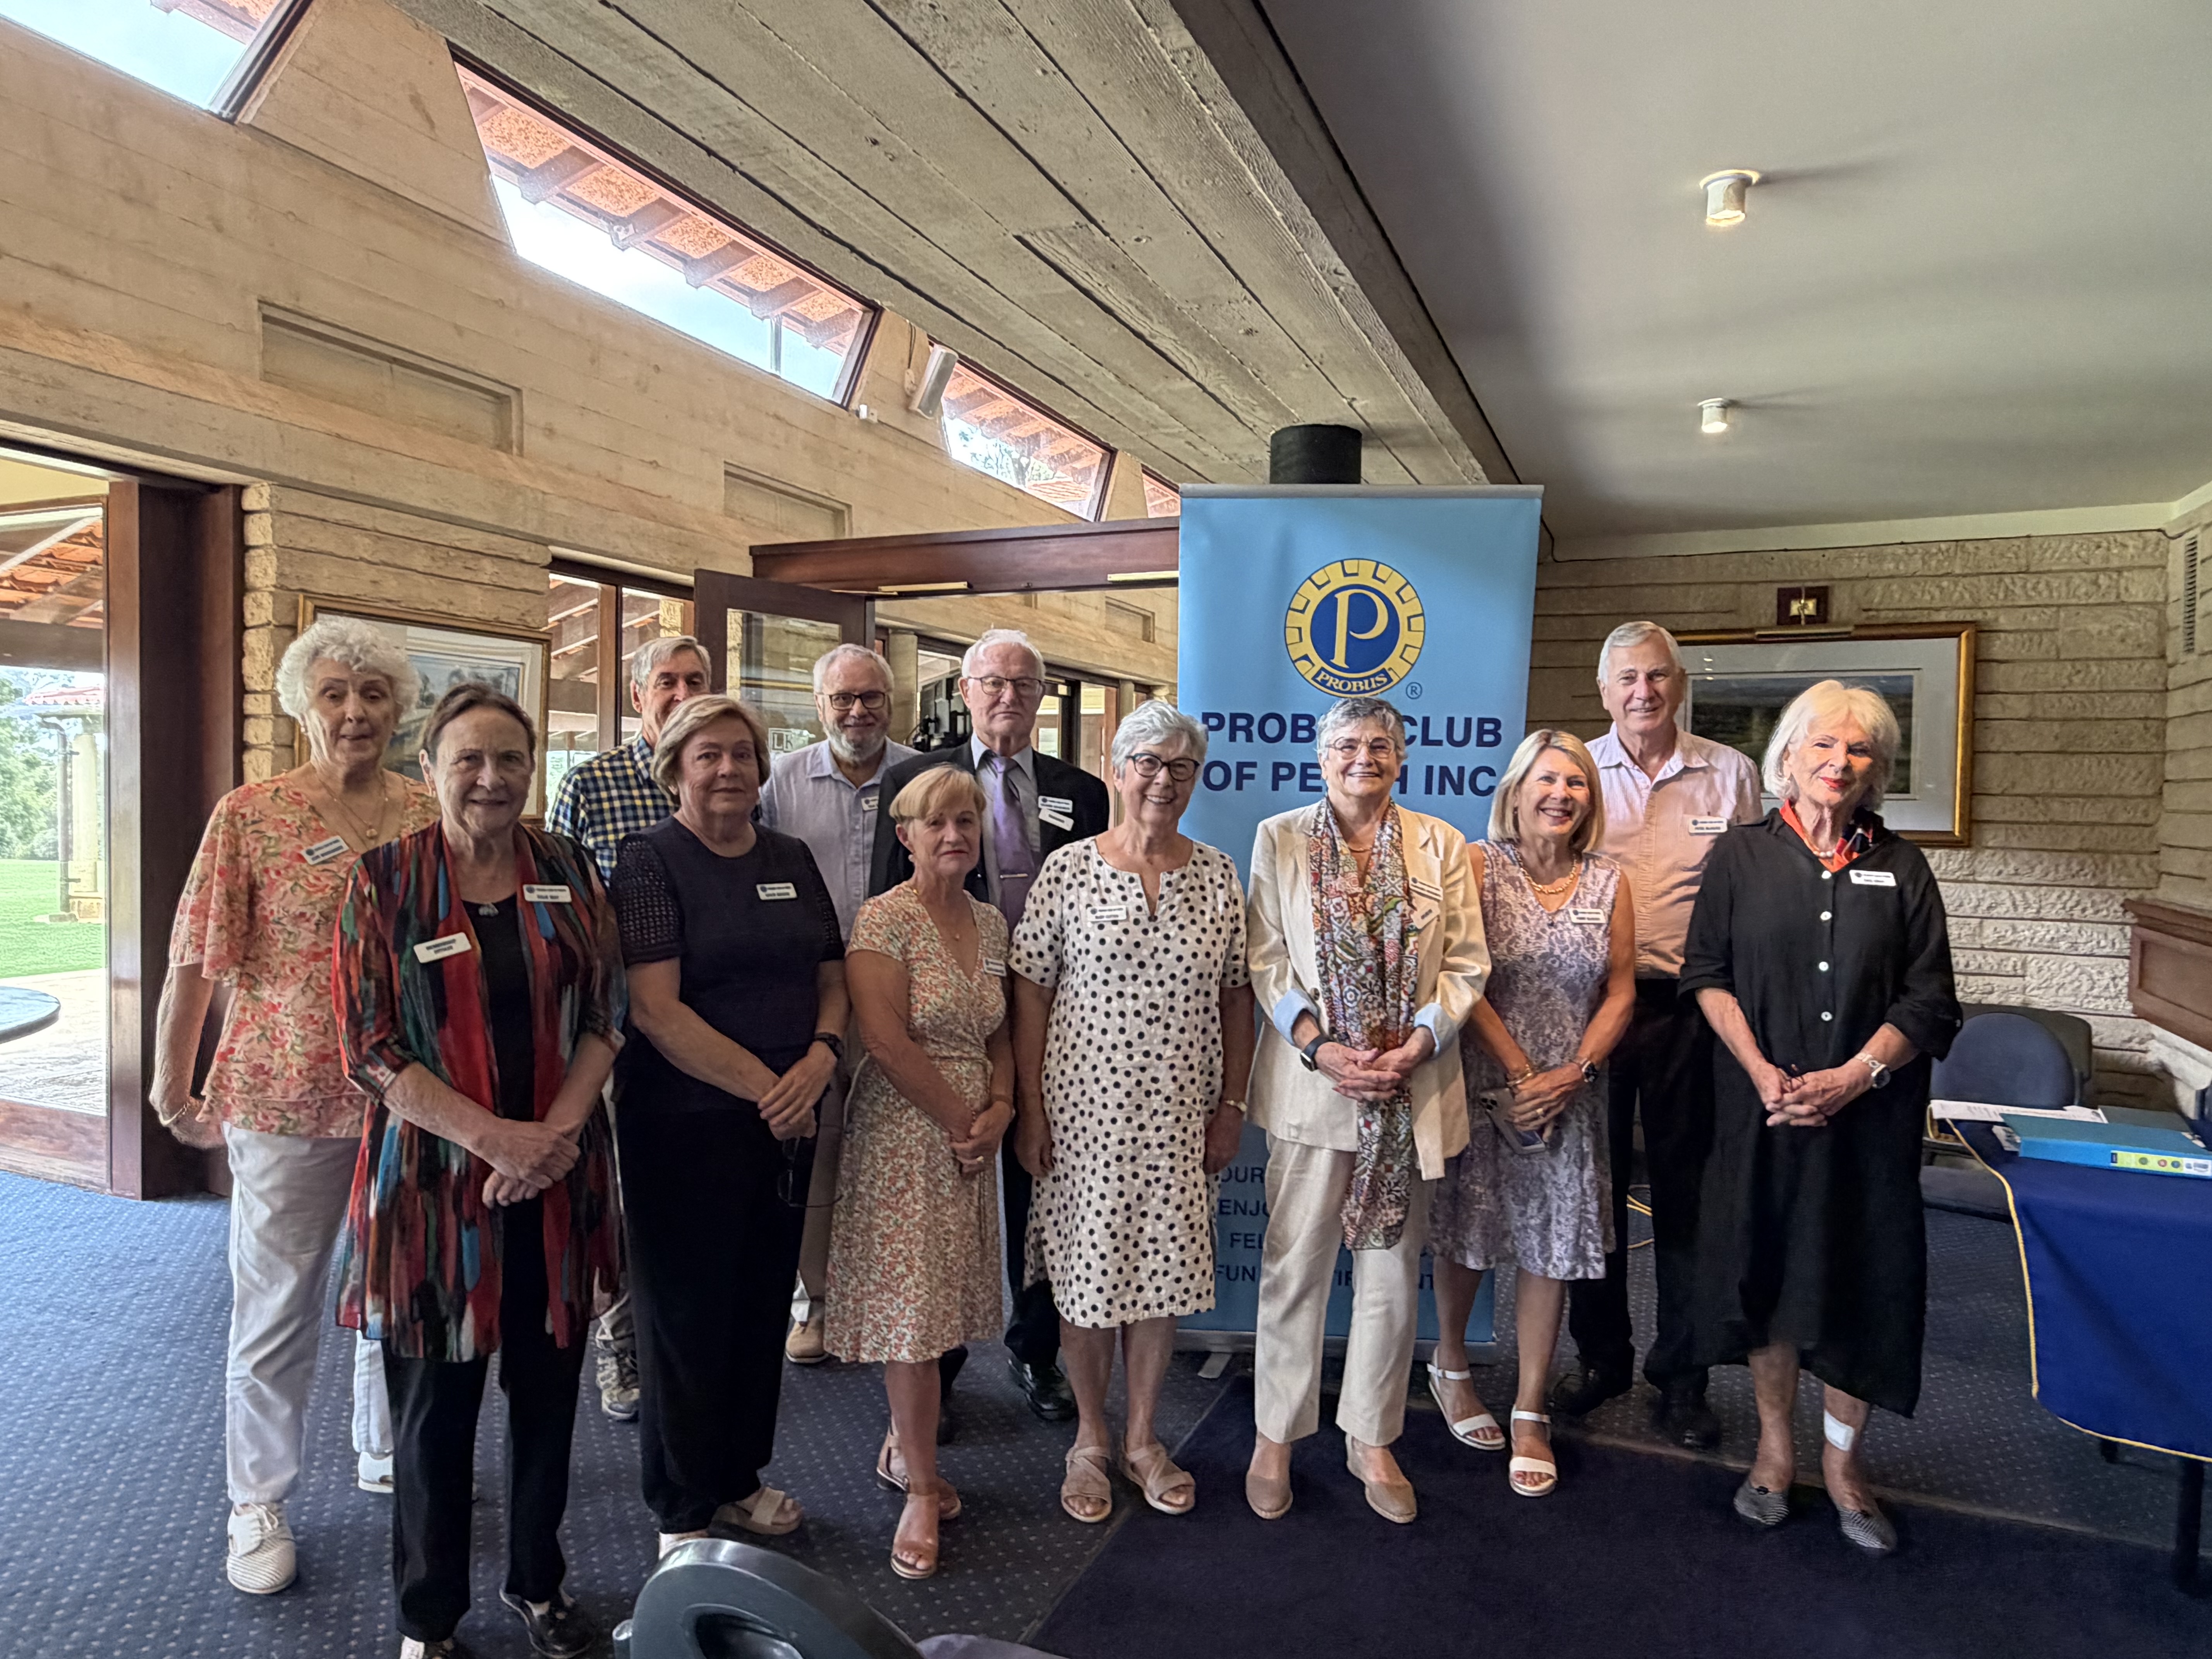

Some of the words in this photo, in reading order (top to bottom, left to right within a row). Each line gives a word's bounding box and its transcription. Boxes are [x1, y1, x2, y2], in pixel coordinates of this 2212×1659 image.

[1330, 589, 1388, 668] P
[1316, 670, 1388, 692] PROBUS
[1201, 712, 1317, 744] PROB
[1202, 760, 1257, 791] OF
[1271, 762, 1408, 794] PEH
[1424, 765, 1496, 797] INC
